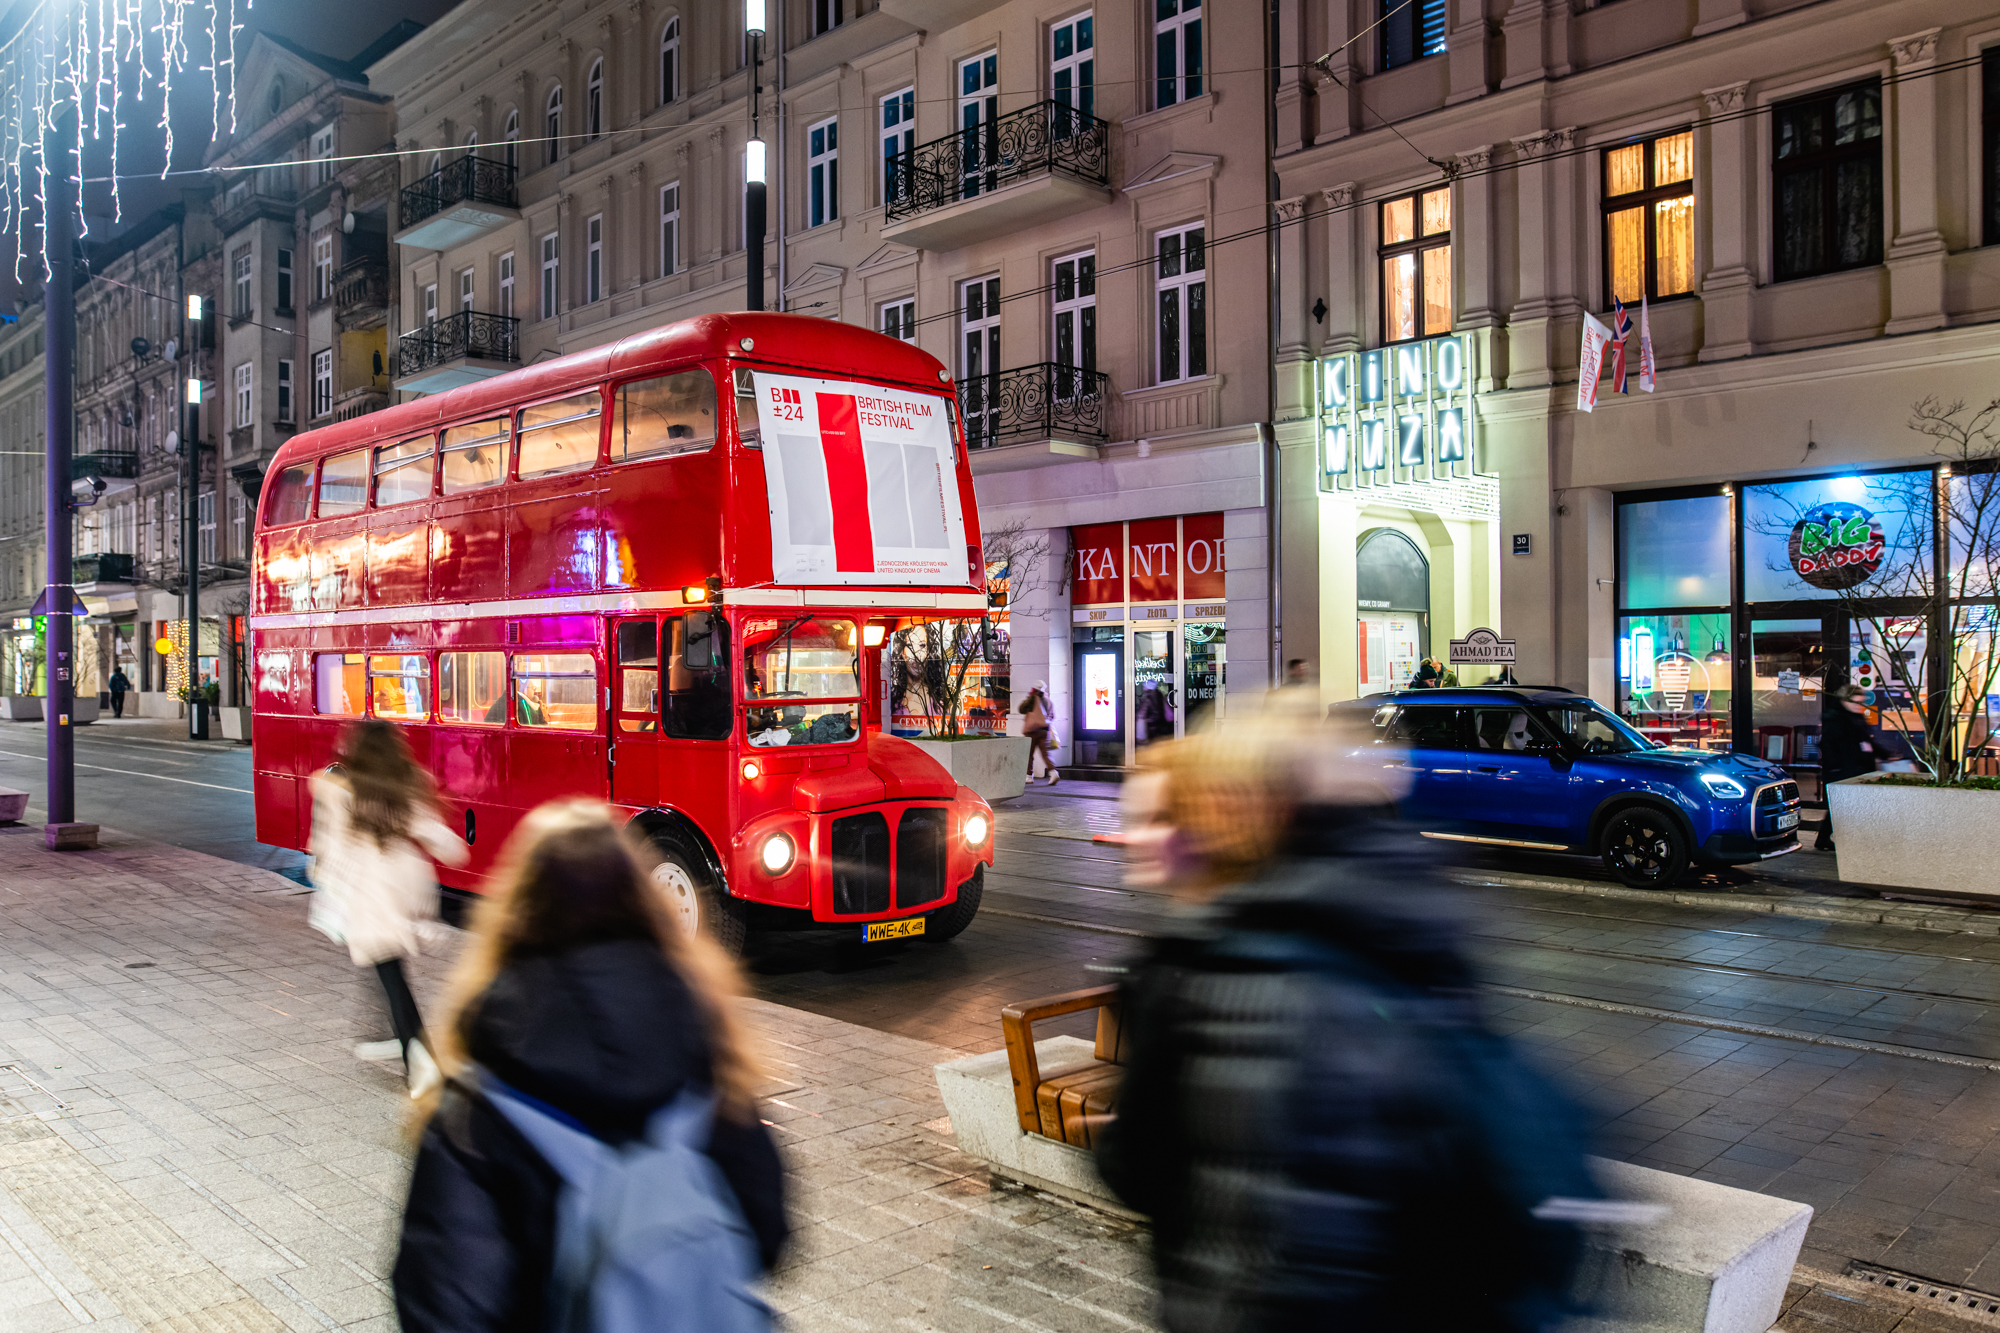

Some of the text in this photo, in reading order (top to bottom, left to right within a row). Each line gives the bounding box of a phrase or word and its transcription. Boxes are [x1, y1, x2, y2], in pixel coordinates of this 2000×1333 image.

[858, 395, 932, 417] BRITISH FILM
[860, 411, 914, 430] FESTIVAL
[1516, 536, 1527, 545] 30
[1799, 542, 1883, 574] DADDY
[1089, 611, 1107, 620] SKUP
[1147, 608, 1168, 618] ZŁOTA
[1452, 646, 1514, 656] AHMAD TEA
[1188, 688, 1198, 699] DO
[899, 717, 942, 728] CENTRM
